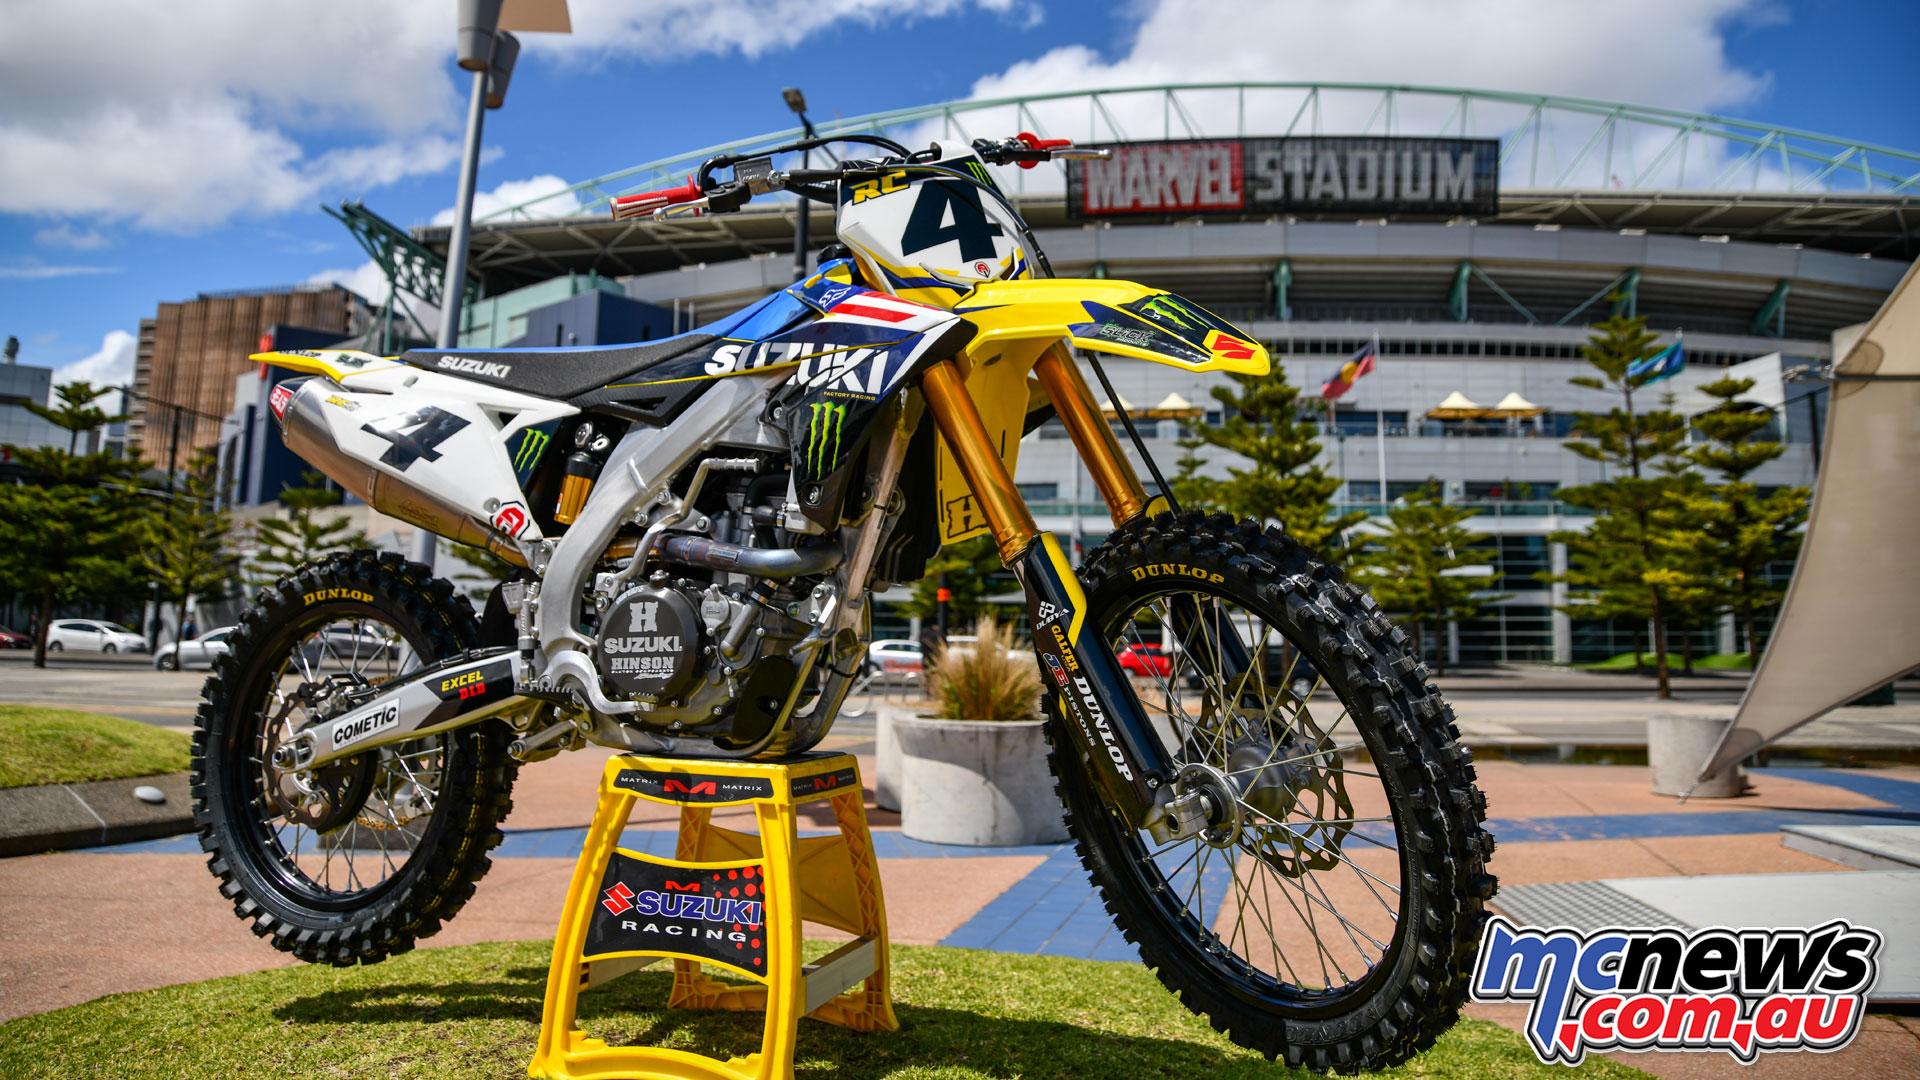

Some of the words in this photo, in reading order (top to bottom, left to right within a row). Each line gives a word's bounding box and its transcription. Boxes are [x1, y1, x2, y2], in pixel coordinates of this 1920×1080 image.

[850, 170, 911, 205] RC
[1087, 144, 1240, 209] MARVEL
[1254, 147, 1476, 201] STADIUM
[900, 178, 1004, 263] 4
[438, 355, 513, 379] SUZUKI
[704, 342, 889, 394] SUZUKI
[851, 393, 876, 401] RACING
[360, 405, 472, 472] 4
[1131, 563, 1225, 583] DUNLOP
[303, 588, 374, 606] DUNLOP
[629, 601, 658, 632] H
[1036, 608, 1069, 630] DUBYA
[604, 636, 680, 654] SUZUKI
[1051, 625, 1079, 671] GALFER
[611, 657, 674, 670] HINSON
[441, 670, 484, 692] EXCEL
[334, 707, 397, 744] COMETIC
[1064, 686, 1096, 746] PISTONS
[1073, 676, 1133, 781] DUNLOP
[722, 784, 762, 792] MATRIX
[636, 890, 762, 926] SUZUKI
[621, 920, 747, 942] RACING
